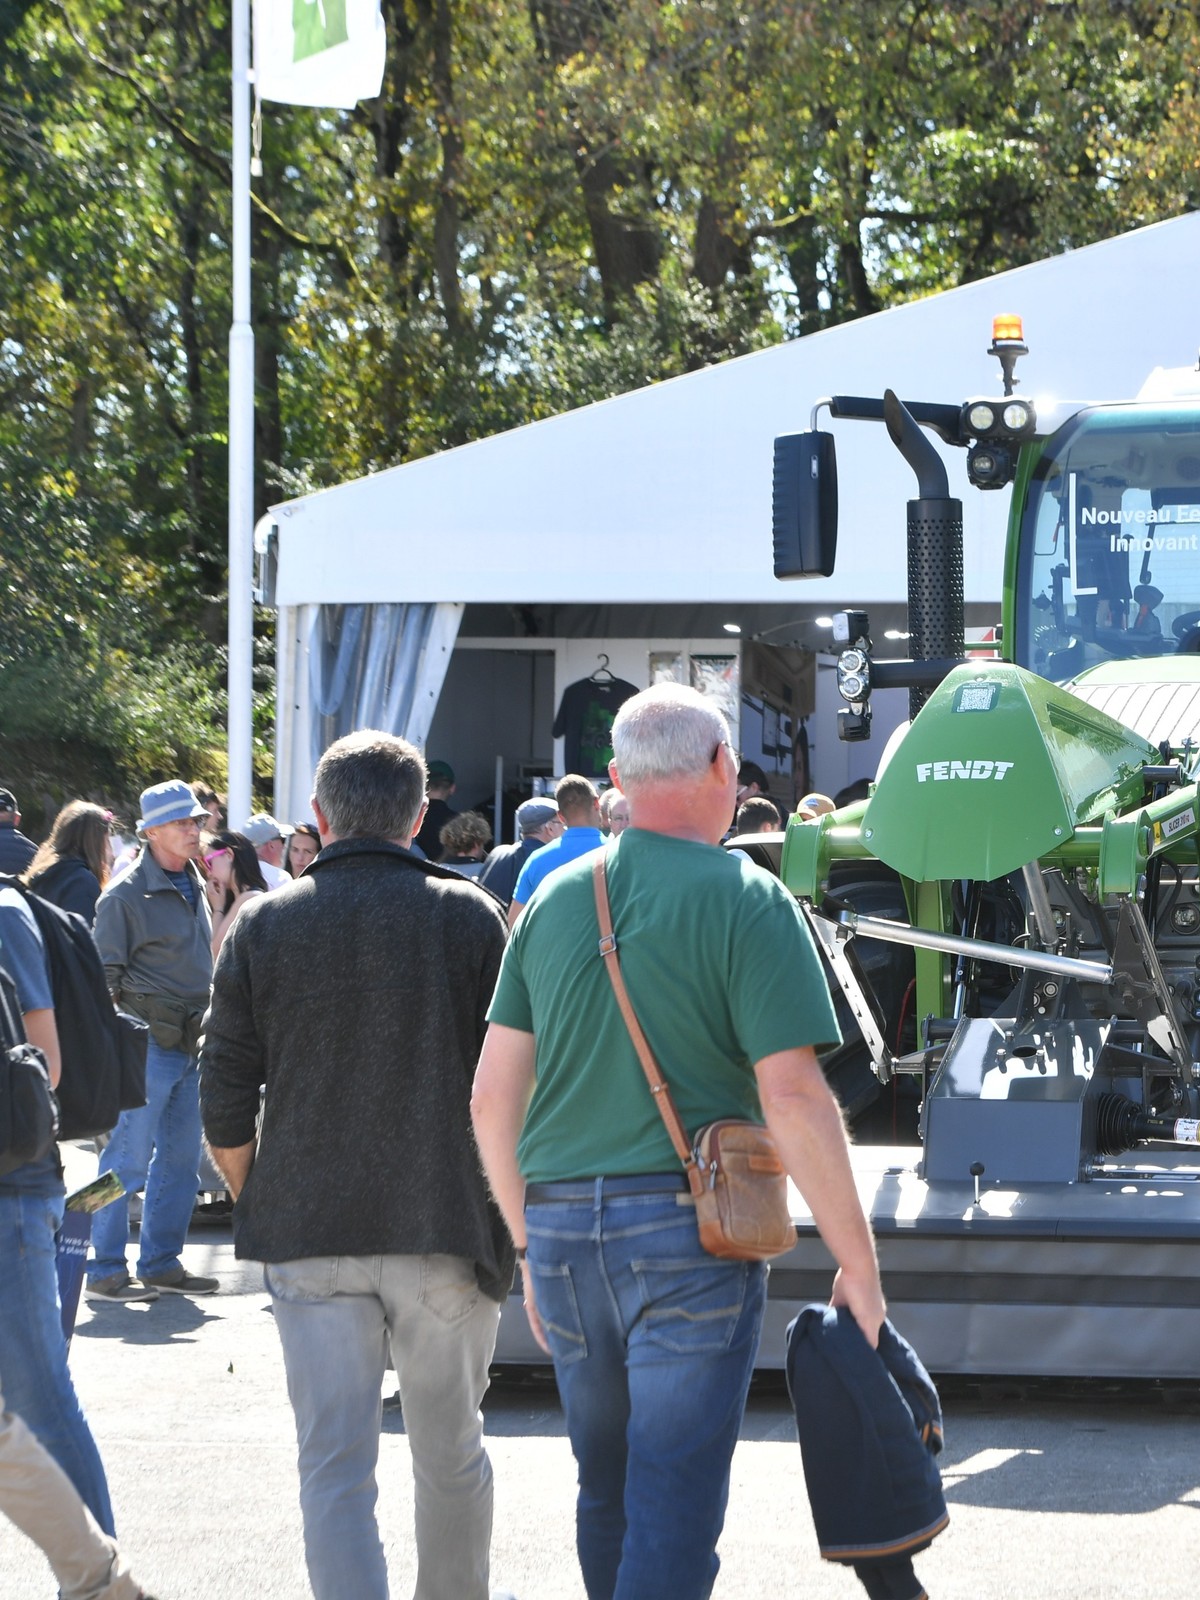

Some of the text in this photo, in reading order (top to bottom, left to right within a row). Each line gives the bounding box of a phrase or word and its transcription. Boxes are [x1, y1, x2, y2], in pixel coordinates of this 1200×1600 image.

[1081, 507, 1171, 525] Nouveau
[1110, 534, 1199, 553] Innovant
[916, 760, 1014, 782] FENDT
